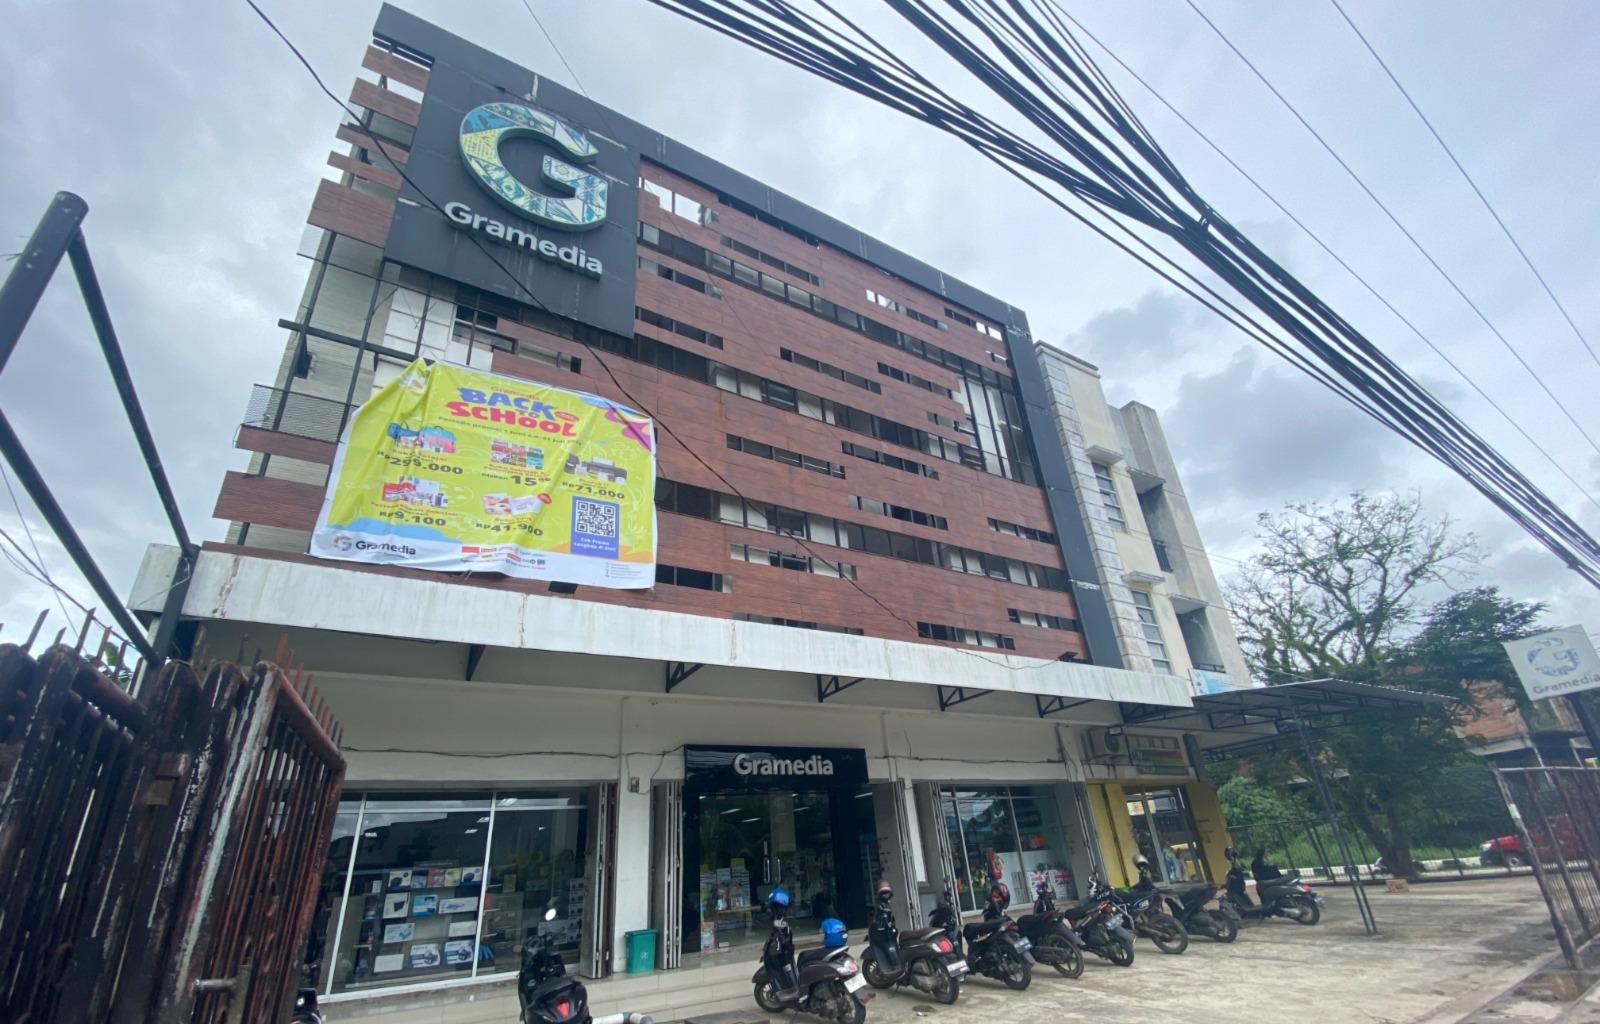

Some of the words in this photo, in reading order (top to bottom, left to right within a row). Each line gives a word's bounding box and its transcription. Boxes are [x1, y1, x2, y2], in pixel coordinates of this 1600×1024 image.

[444, 201, 603, 274] Gramedia
[457, 387, 555, 421] BACK
[446, 401, 577, 437] SCHOOL
[562, 481, 625, 499] Rp71.000
[379, 510, 447, 526] Rp9.100
[355, 540, 416, 556] Gramedia
[1533, 673, 1600, 694] Gramedia
[734, 753, 834, 776] Gramedia
